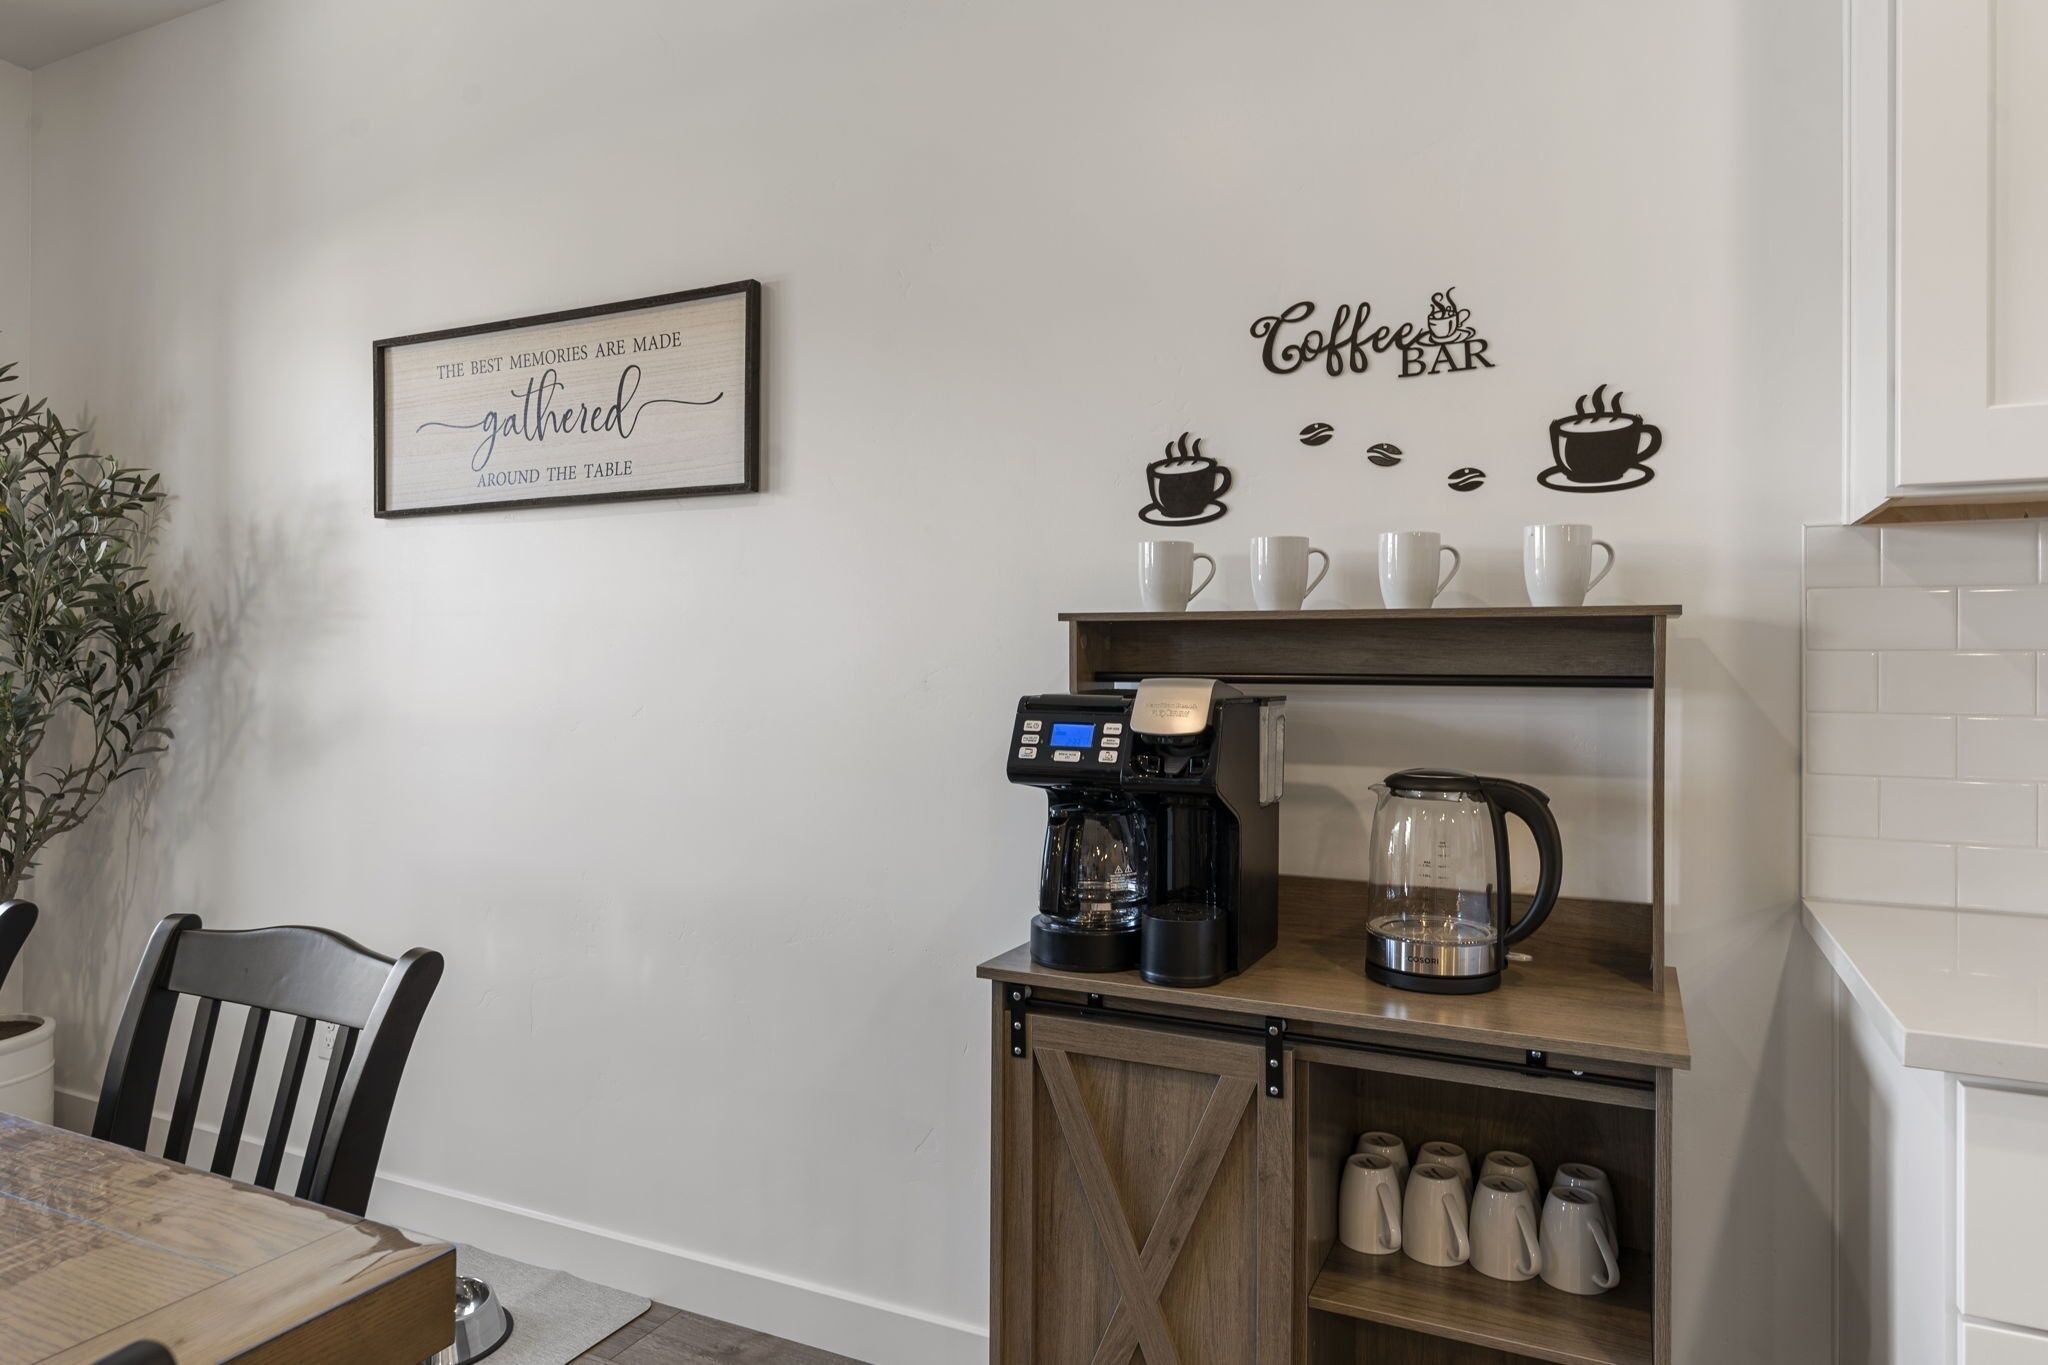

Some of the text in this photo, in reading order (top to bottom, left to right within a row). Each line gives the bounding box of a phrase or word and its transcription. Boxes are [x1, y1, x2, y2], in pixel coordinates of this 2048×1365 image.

[437, 331, 682, 380] THE BEST MEMORIES ARE MADE
[1250, 302, 1422, 377] Coffee
[1398, 338, 1496, 378] BAR
[416, 364, 724, 472] gathered
[476, 460, 633, 488] AROUND THE TABLE
[1408, 955, 1439, 965] COSORI
